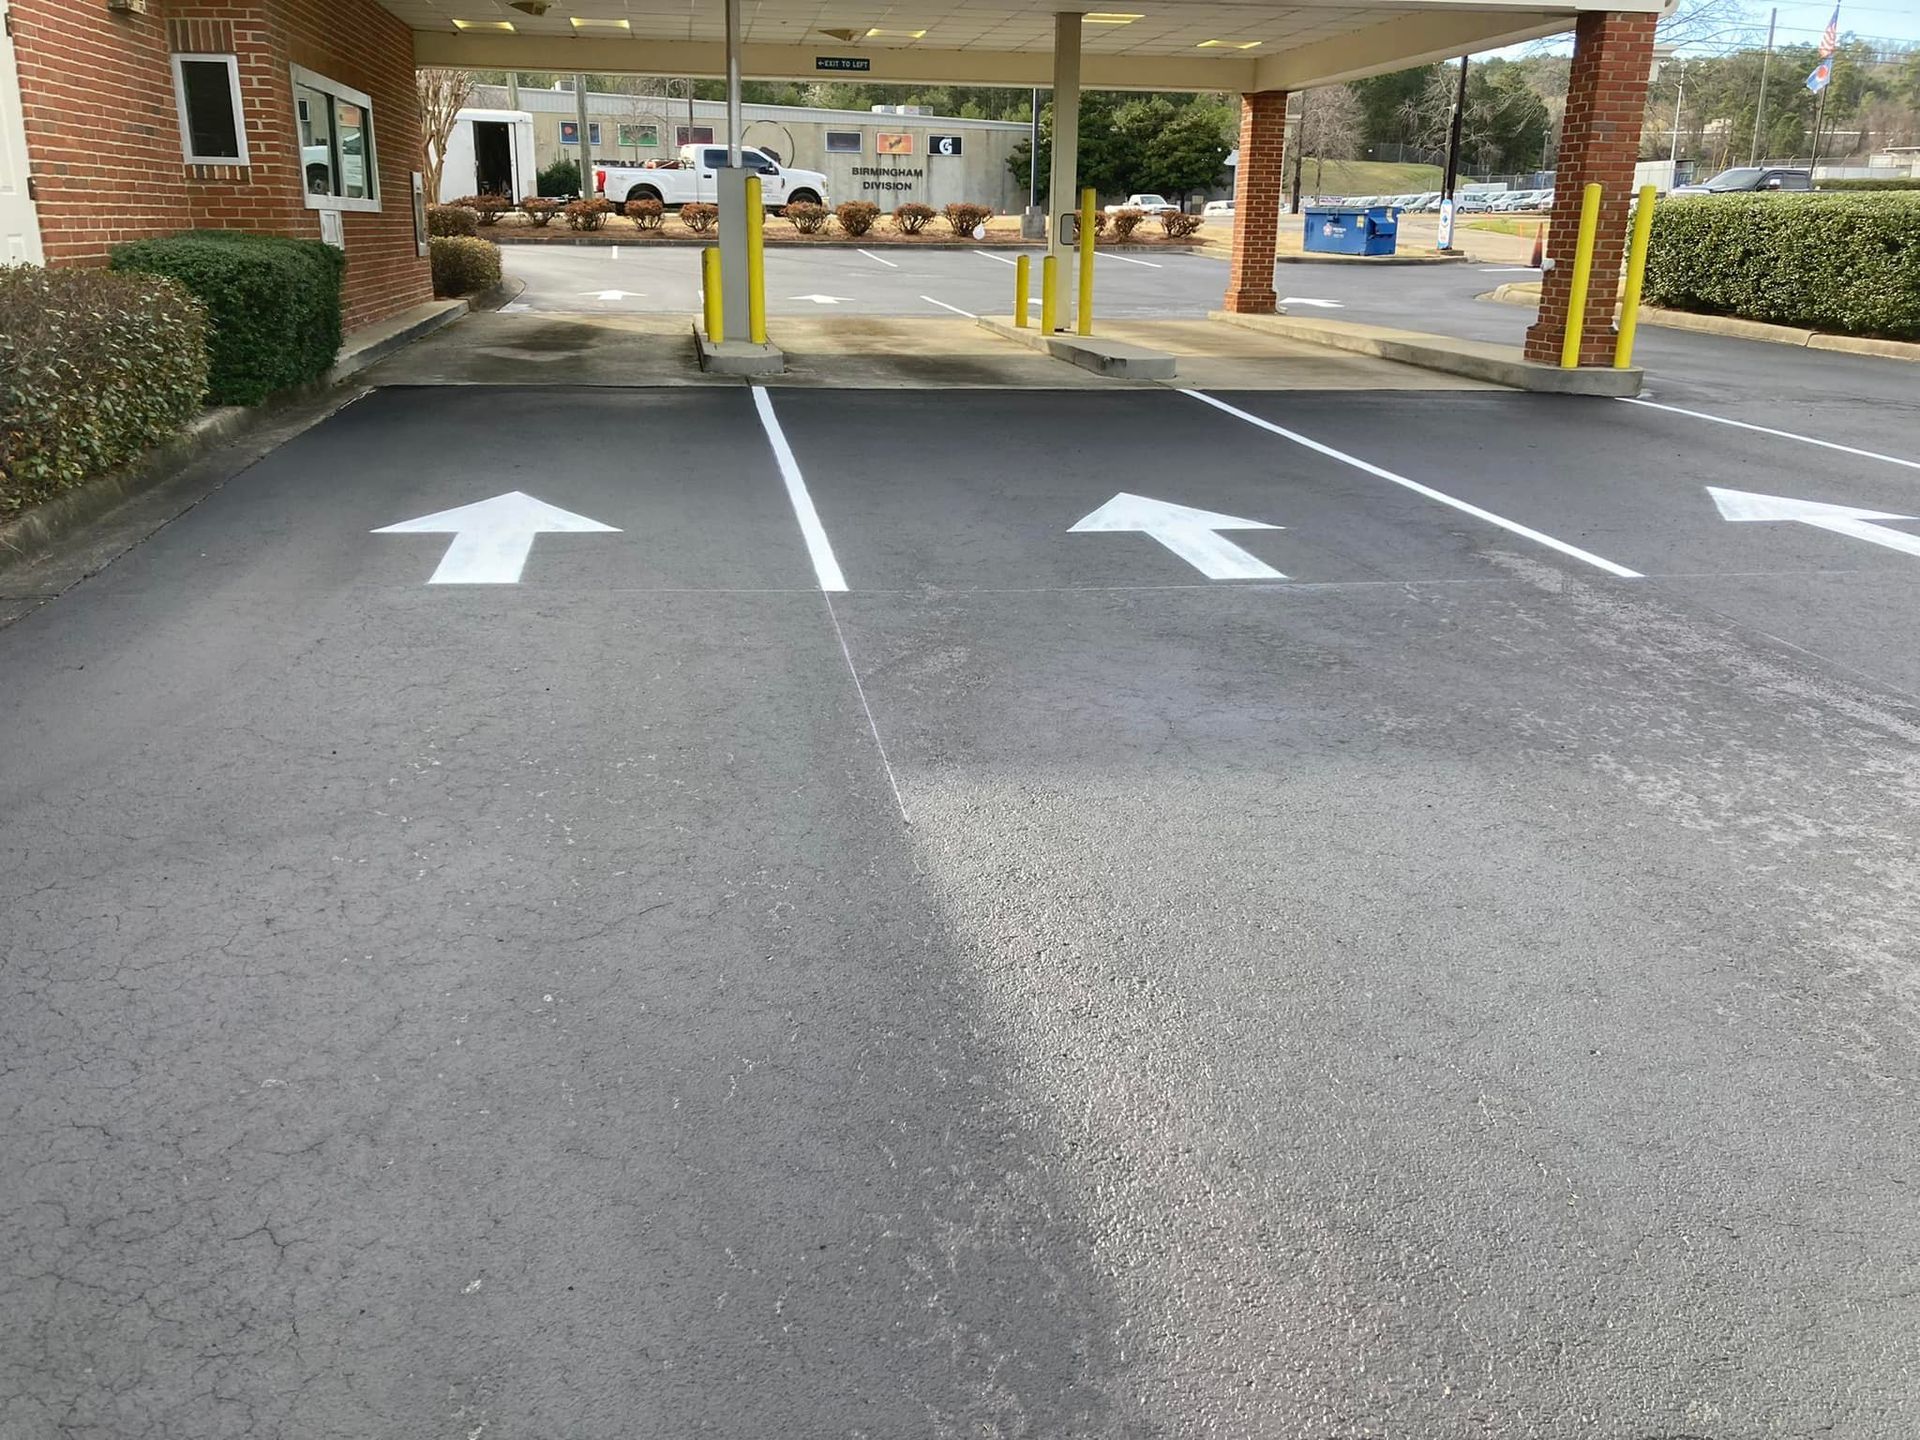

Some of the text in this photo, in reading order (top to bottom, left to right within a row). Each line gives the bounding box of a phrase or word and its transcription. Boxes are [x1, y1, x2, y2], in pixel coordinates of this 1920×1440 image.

[842, 60, 851, 68] TO
[939, 137, 952, 155] G
[852, 167, 923, 178] BIRMINGHAM
[863, 181, 912, 191] DIVISION
